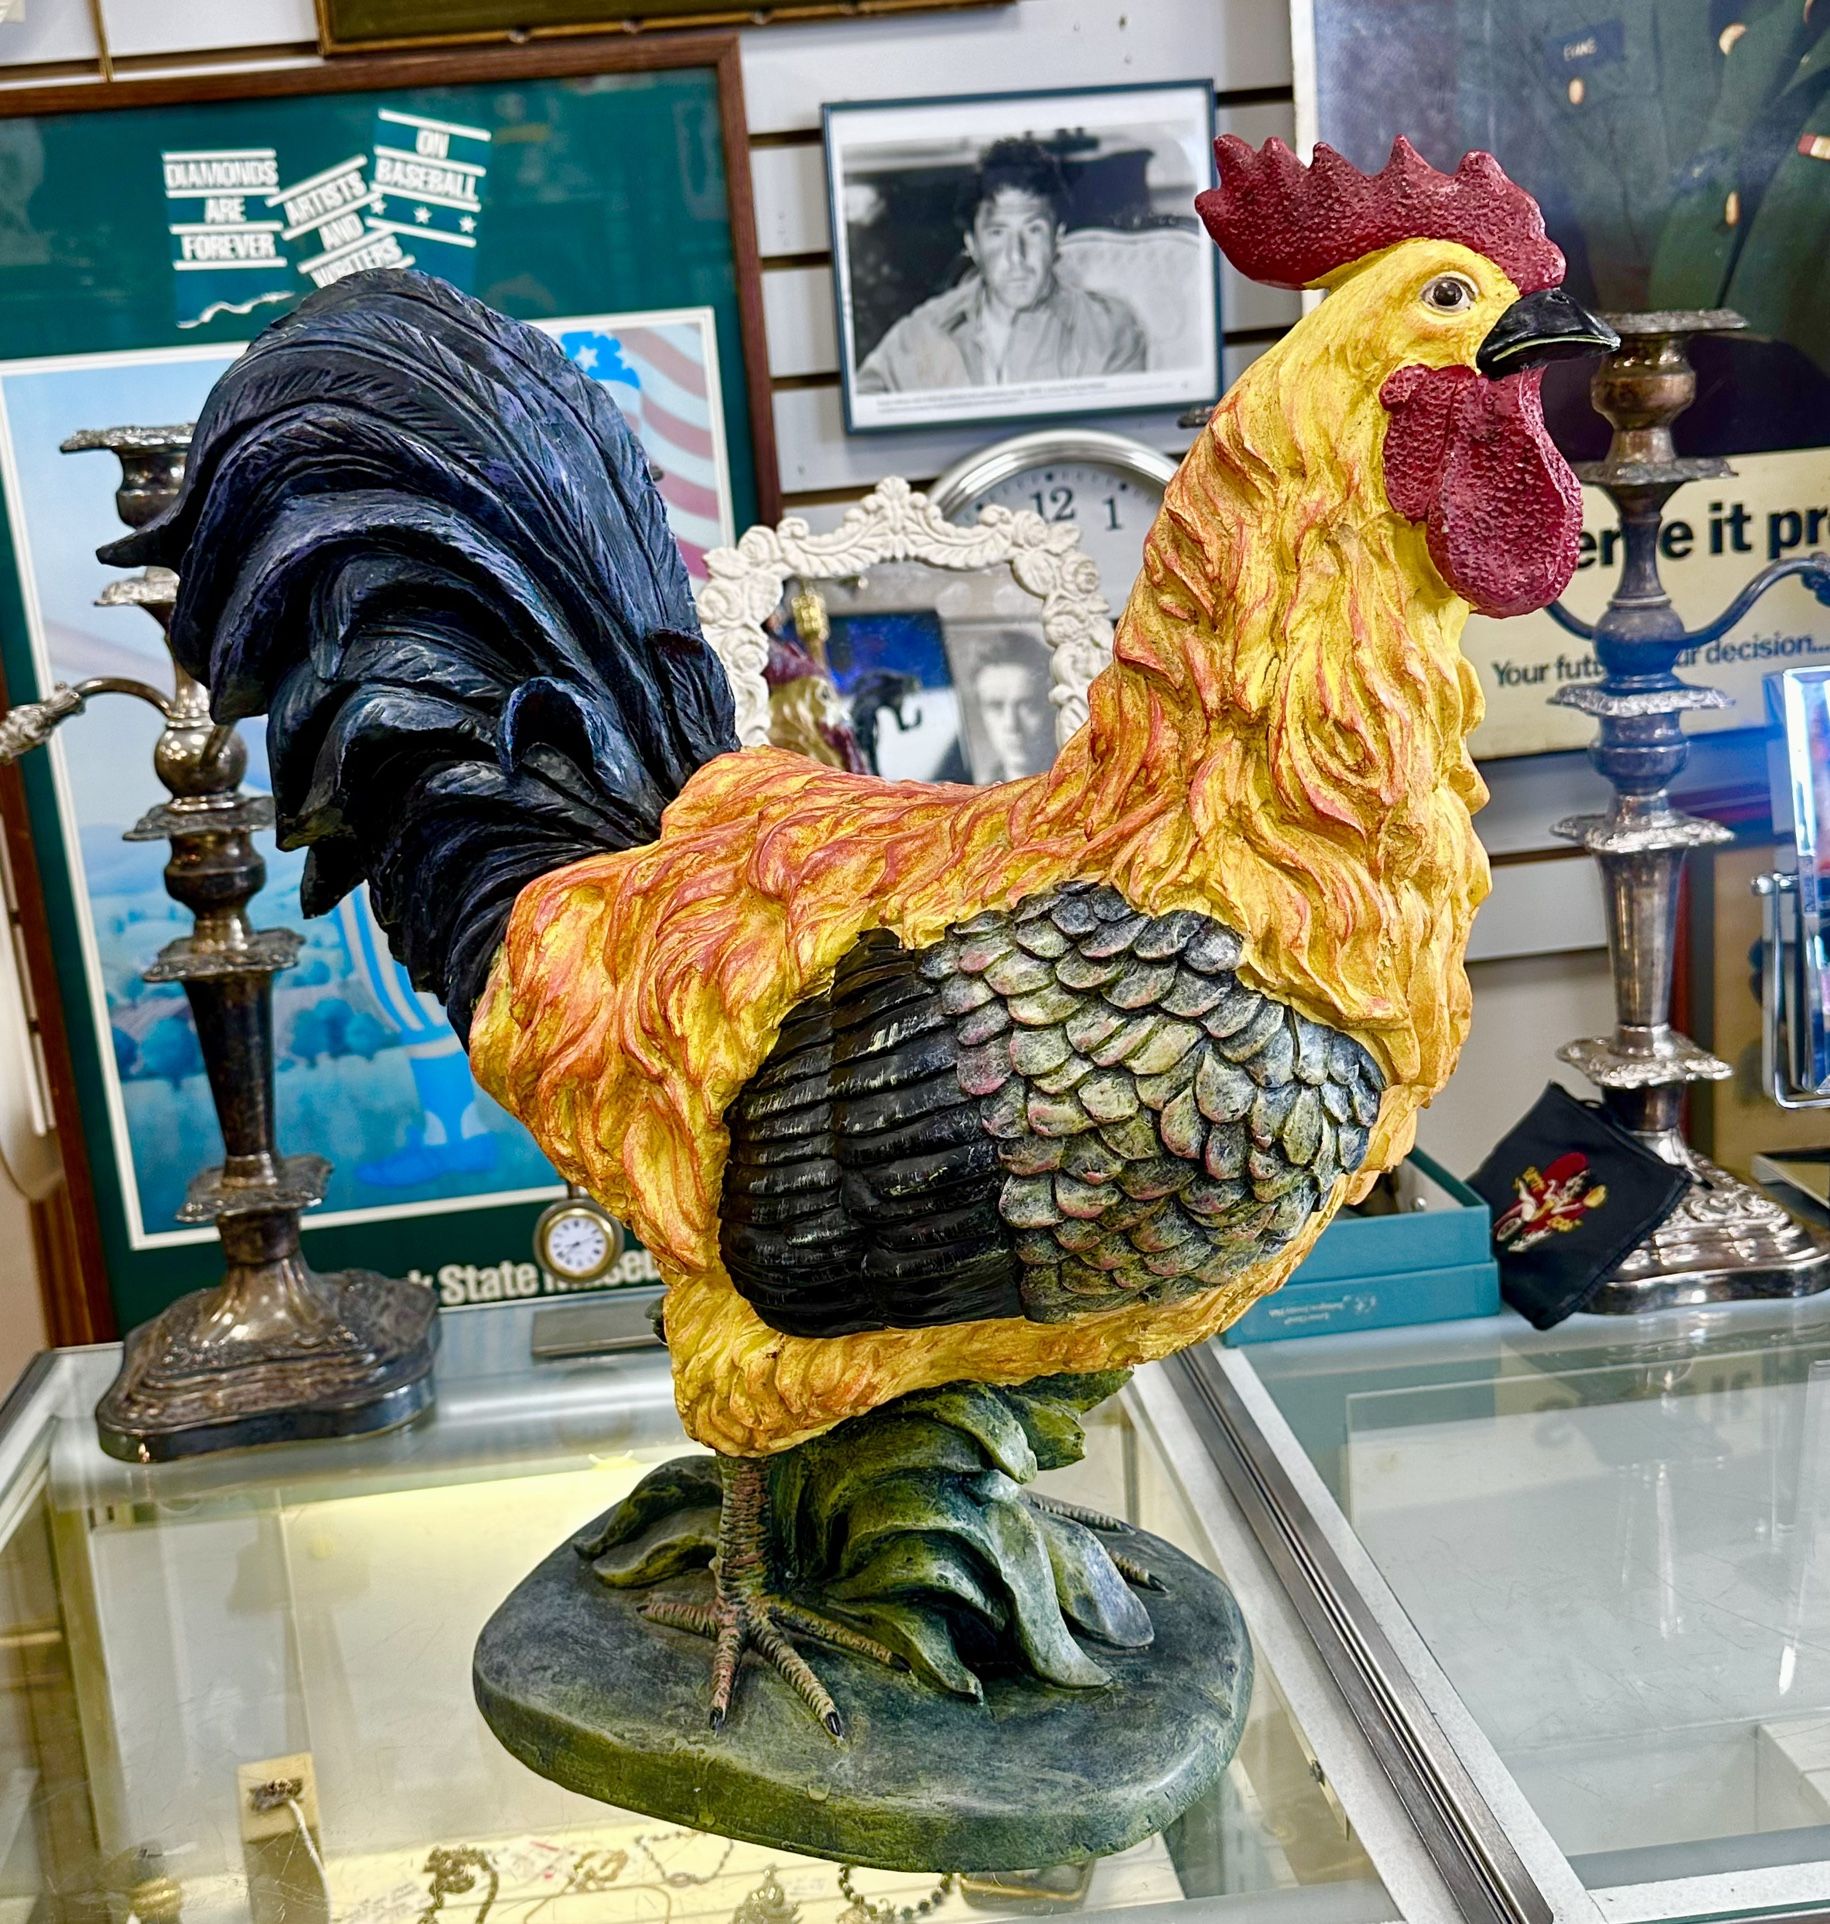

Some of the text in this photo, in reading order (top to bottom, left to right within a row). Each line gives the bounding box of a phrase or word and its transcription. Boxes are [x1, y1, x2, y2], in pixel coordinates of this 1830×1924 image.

[416, 129, 449, 158] ON
[164, 159, 279, 187] DIAMONDS
[375, 158, 479, 201] BASEBALL
[204, 197, 246, 223] ARE
[284, 171, 367, 226] ARTISTS
[181, 232, 276, 260] FOREVER
[319, 212, 364, 250] AND
[1030, 487, 1076, 523] 12
[1103, 498, 1122, 531] 1
[1709, 500, 1752, 554] it
[1768, 507, 1830, 560] pr
[1492, 660, 1548, 686] Your
[437, 1260, 539, 1305] State
